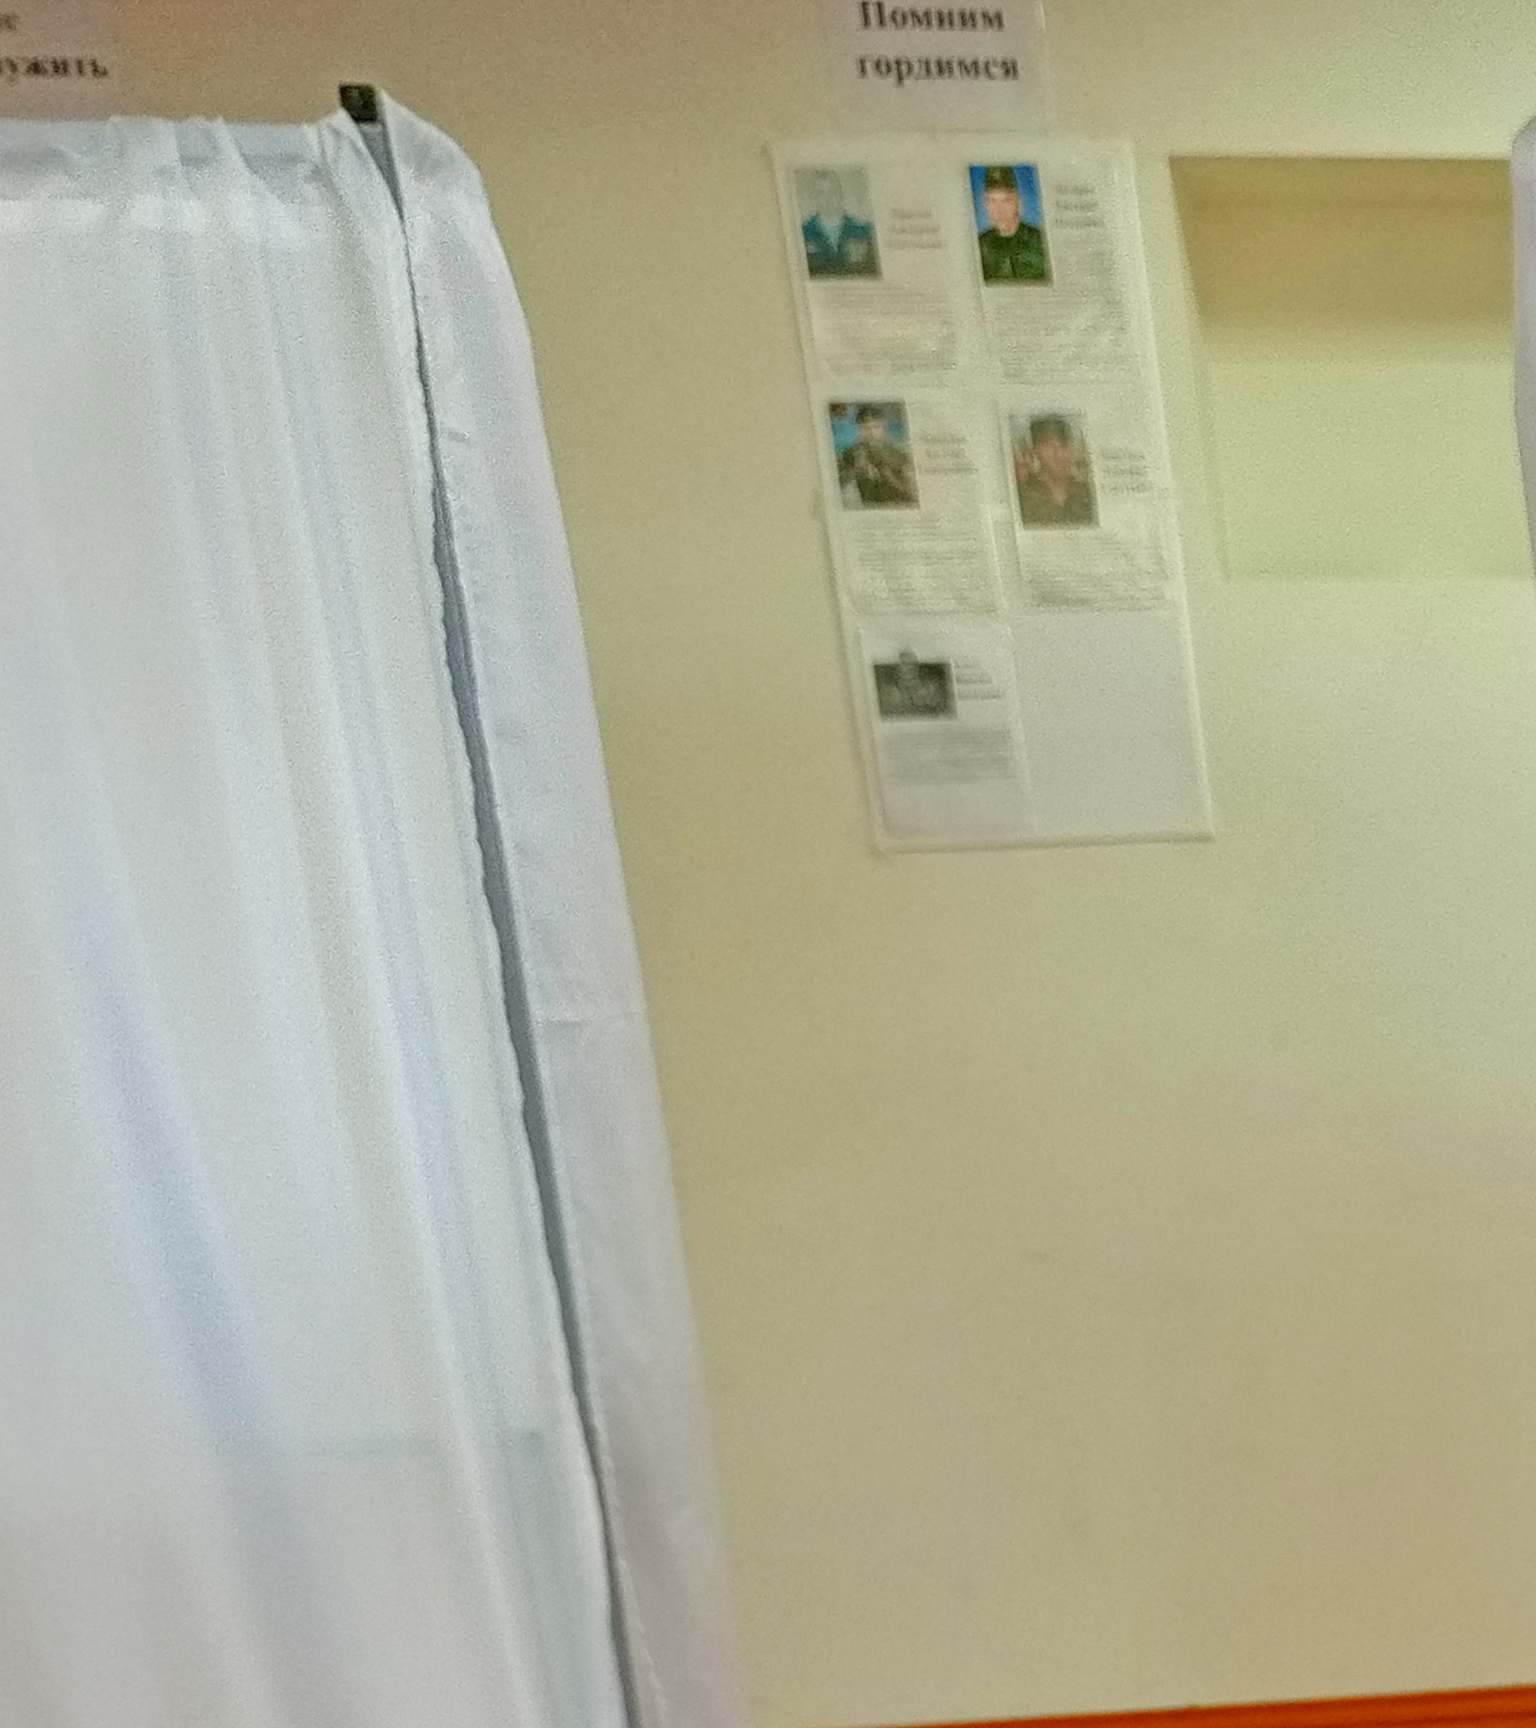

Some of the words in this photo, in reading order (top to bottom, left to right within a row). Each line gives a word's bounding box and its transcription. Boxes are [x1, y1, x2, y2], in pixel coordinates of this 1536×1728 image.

[857, 0, 1004, 31] Помним
[0, 56, 109, 87] ужить
[856, 55, 1019, 89] гордимся
